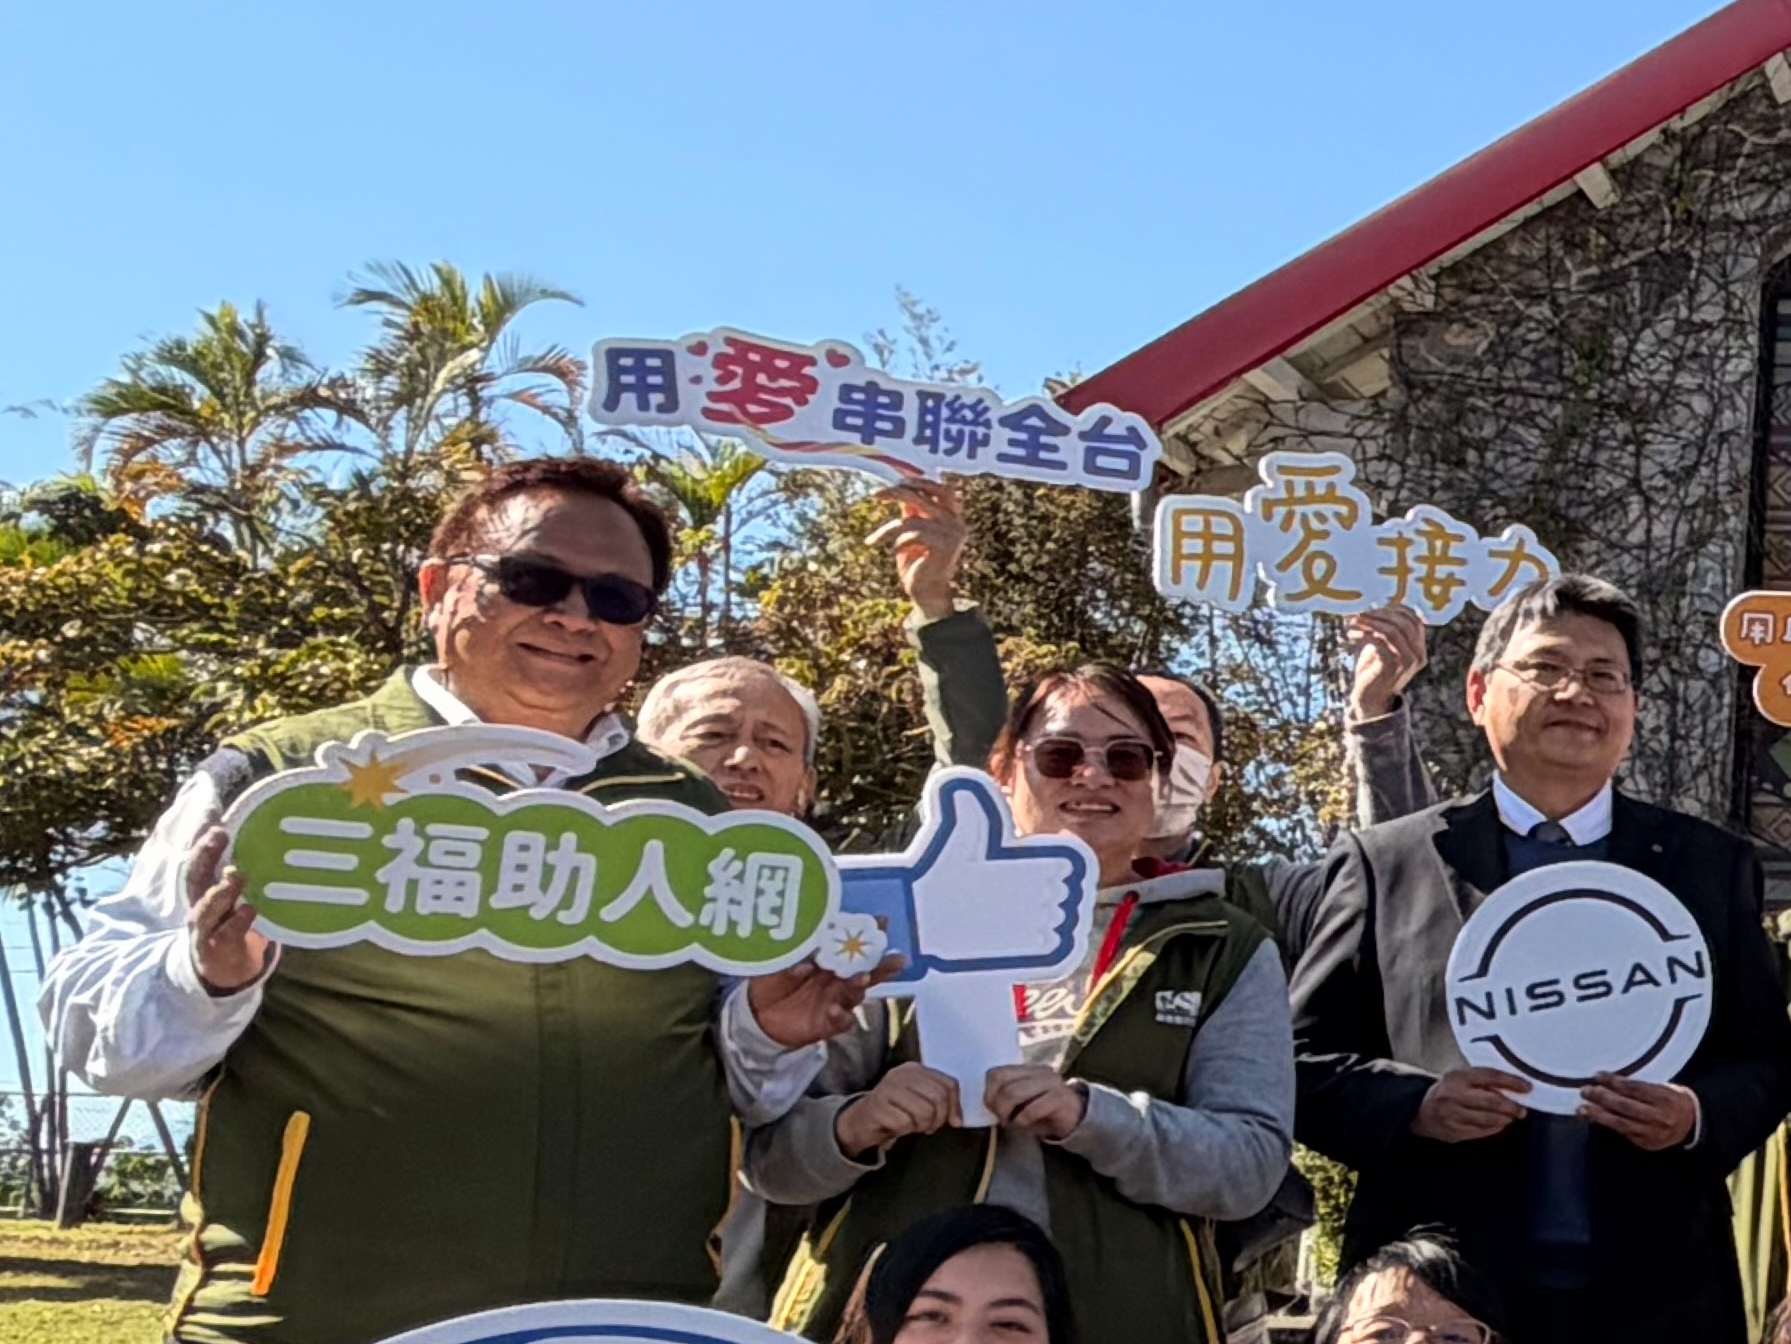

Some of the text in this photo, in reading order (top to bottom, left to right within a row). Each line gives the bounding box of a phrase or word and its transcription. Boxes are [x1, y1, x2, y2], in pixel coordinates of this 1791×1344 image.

[602, 337, 1149, 480] 用愛串聯全台
[1171, 465, 1549, 610] 用愛接力
[262, 817, 804, 941] 三福助人網
[1456, 950, 1706, 1027] NISSAN
